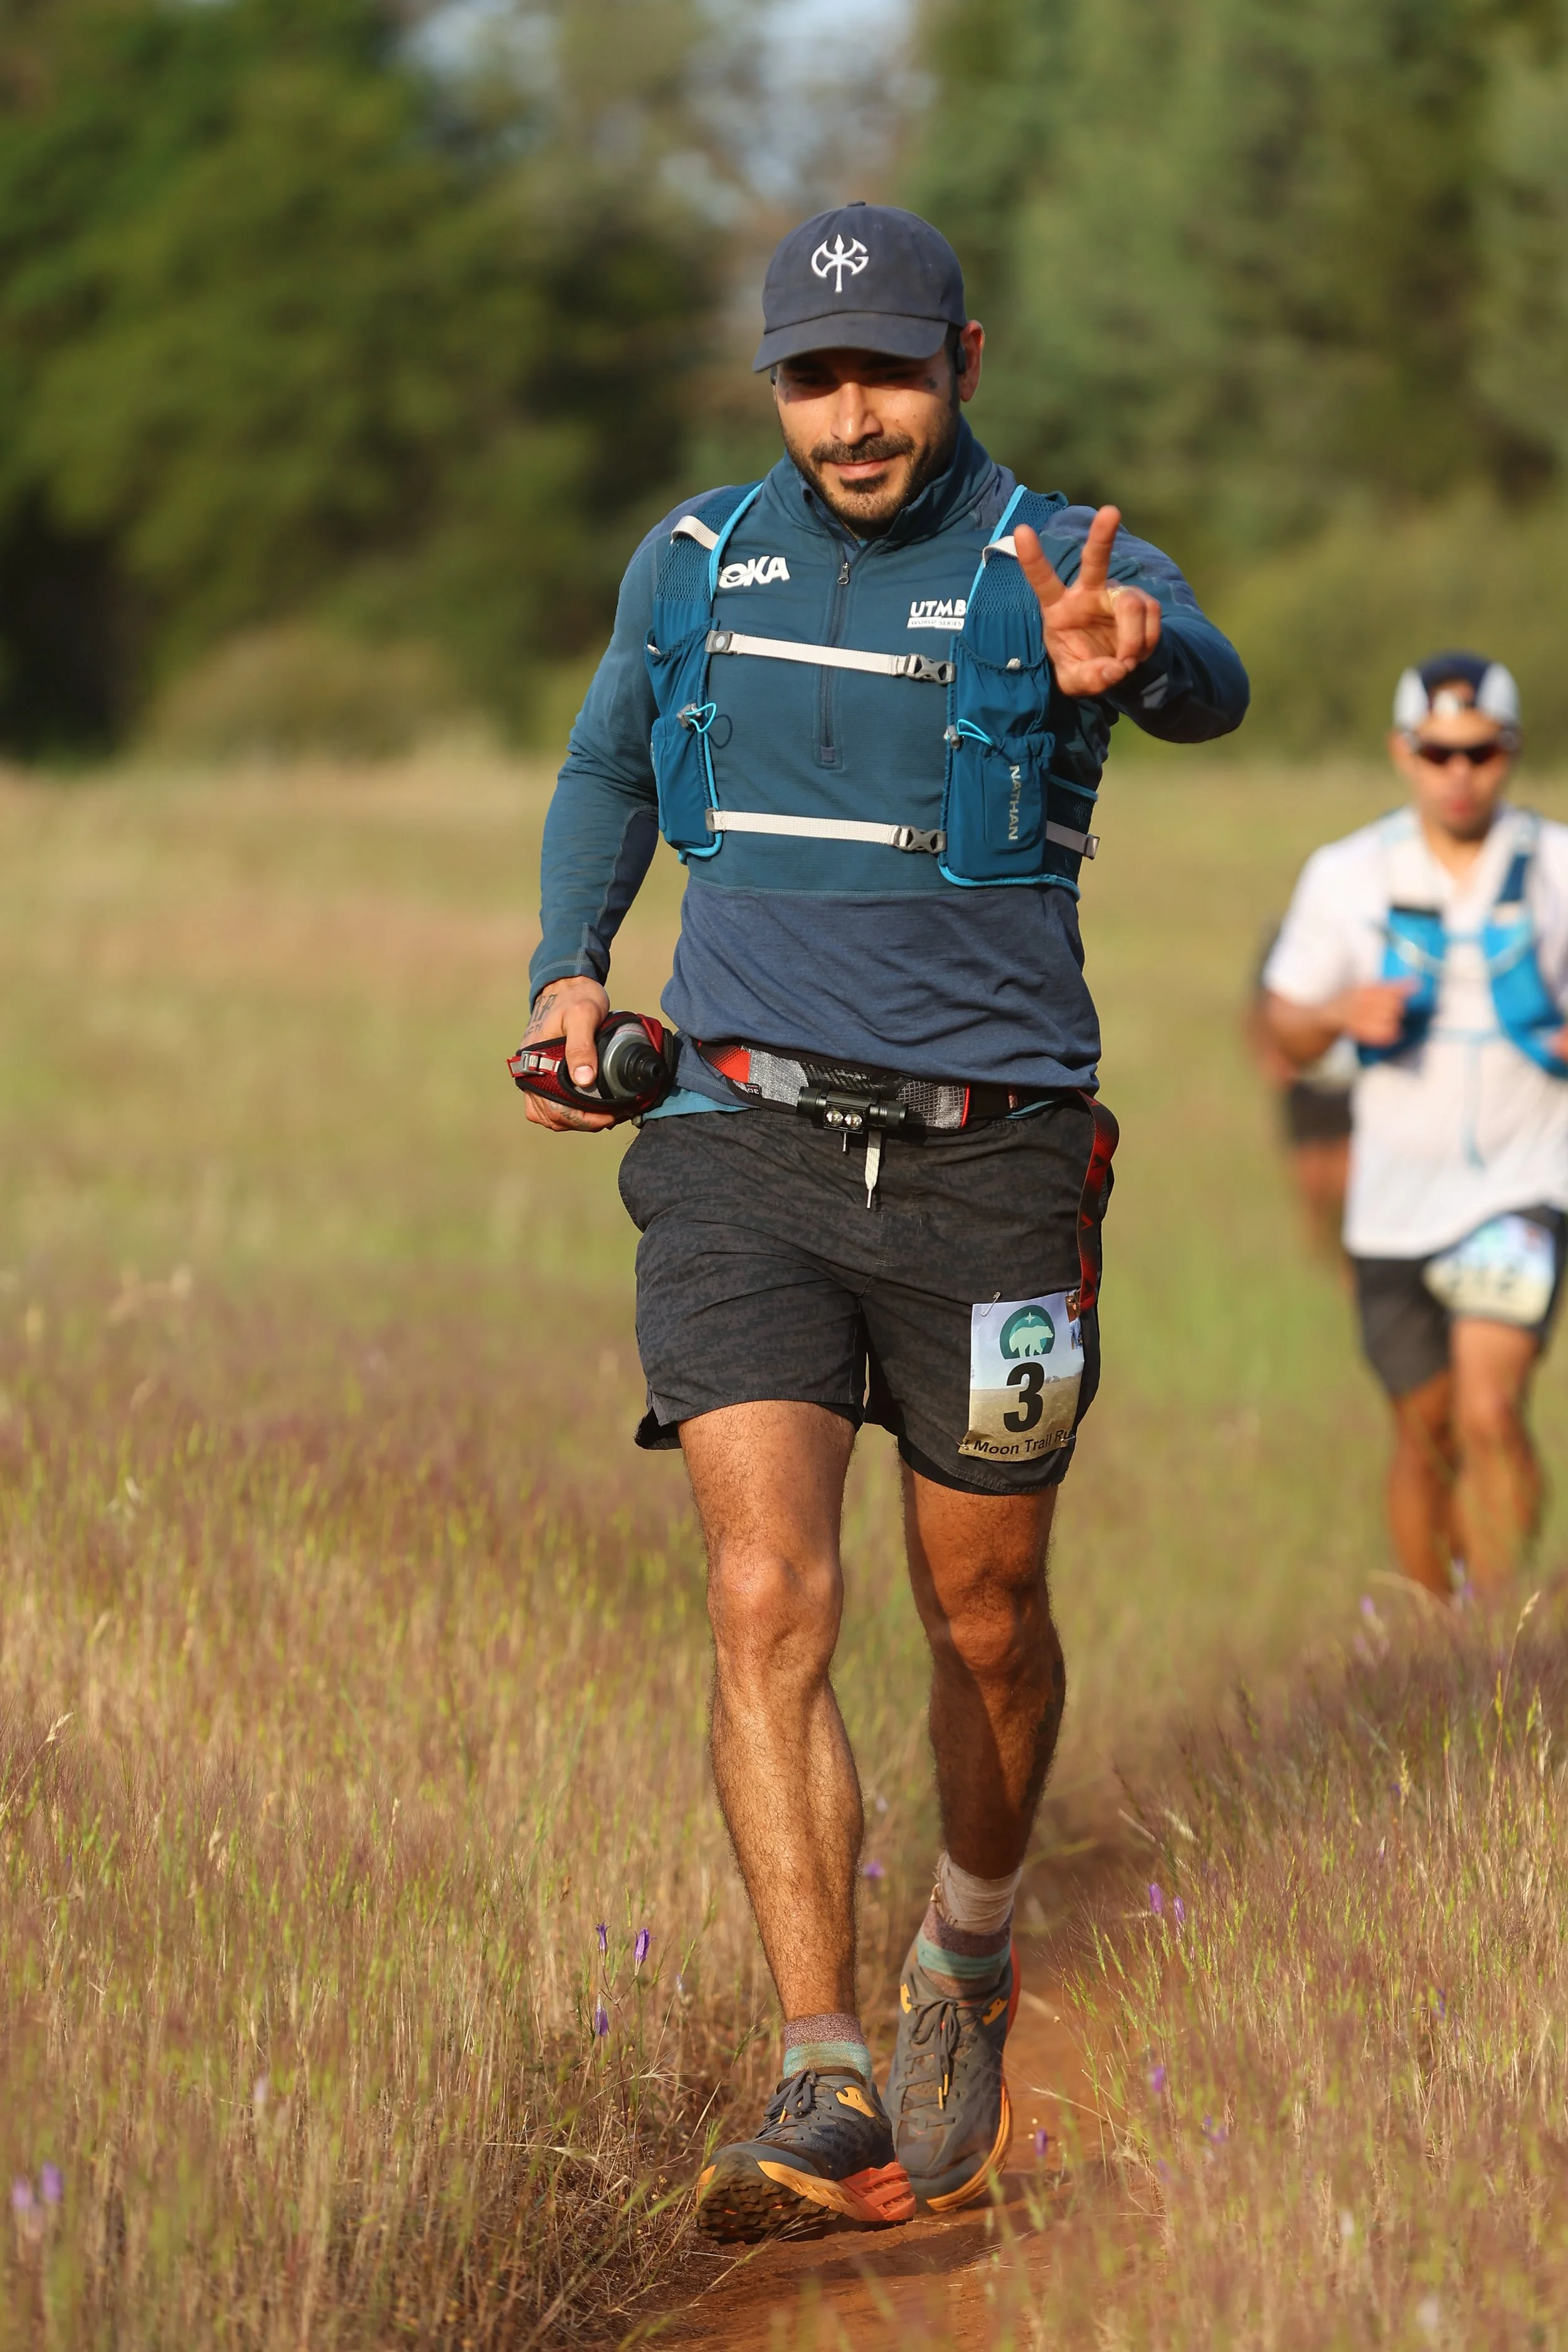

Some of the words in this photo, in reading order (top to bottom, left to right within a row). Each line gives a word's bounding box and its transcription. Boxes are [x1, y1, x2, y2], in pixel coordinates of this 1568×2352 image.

[719, 556, 790, 588] OKA
[910, 598, 966, 617] UTMB
[1009, 765, 1021, 840] NATHAN
[1004, 1362, 1045, 1433] 3
[973, 1440, 1019, 1454] Moon
[1024, 1433, 1052, 1453] Trail
[1055, 1429, 1072, 1443] Ru
